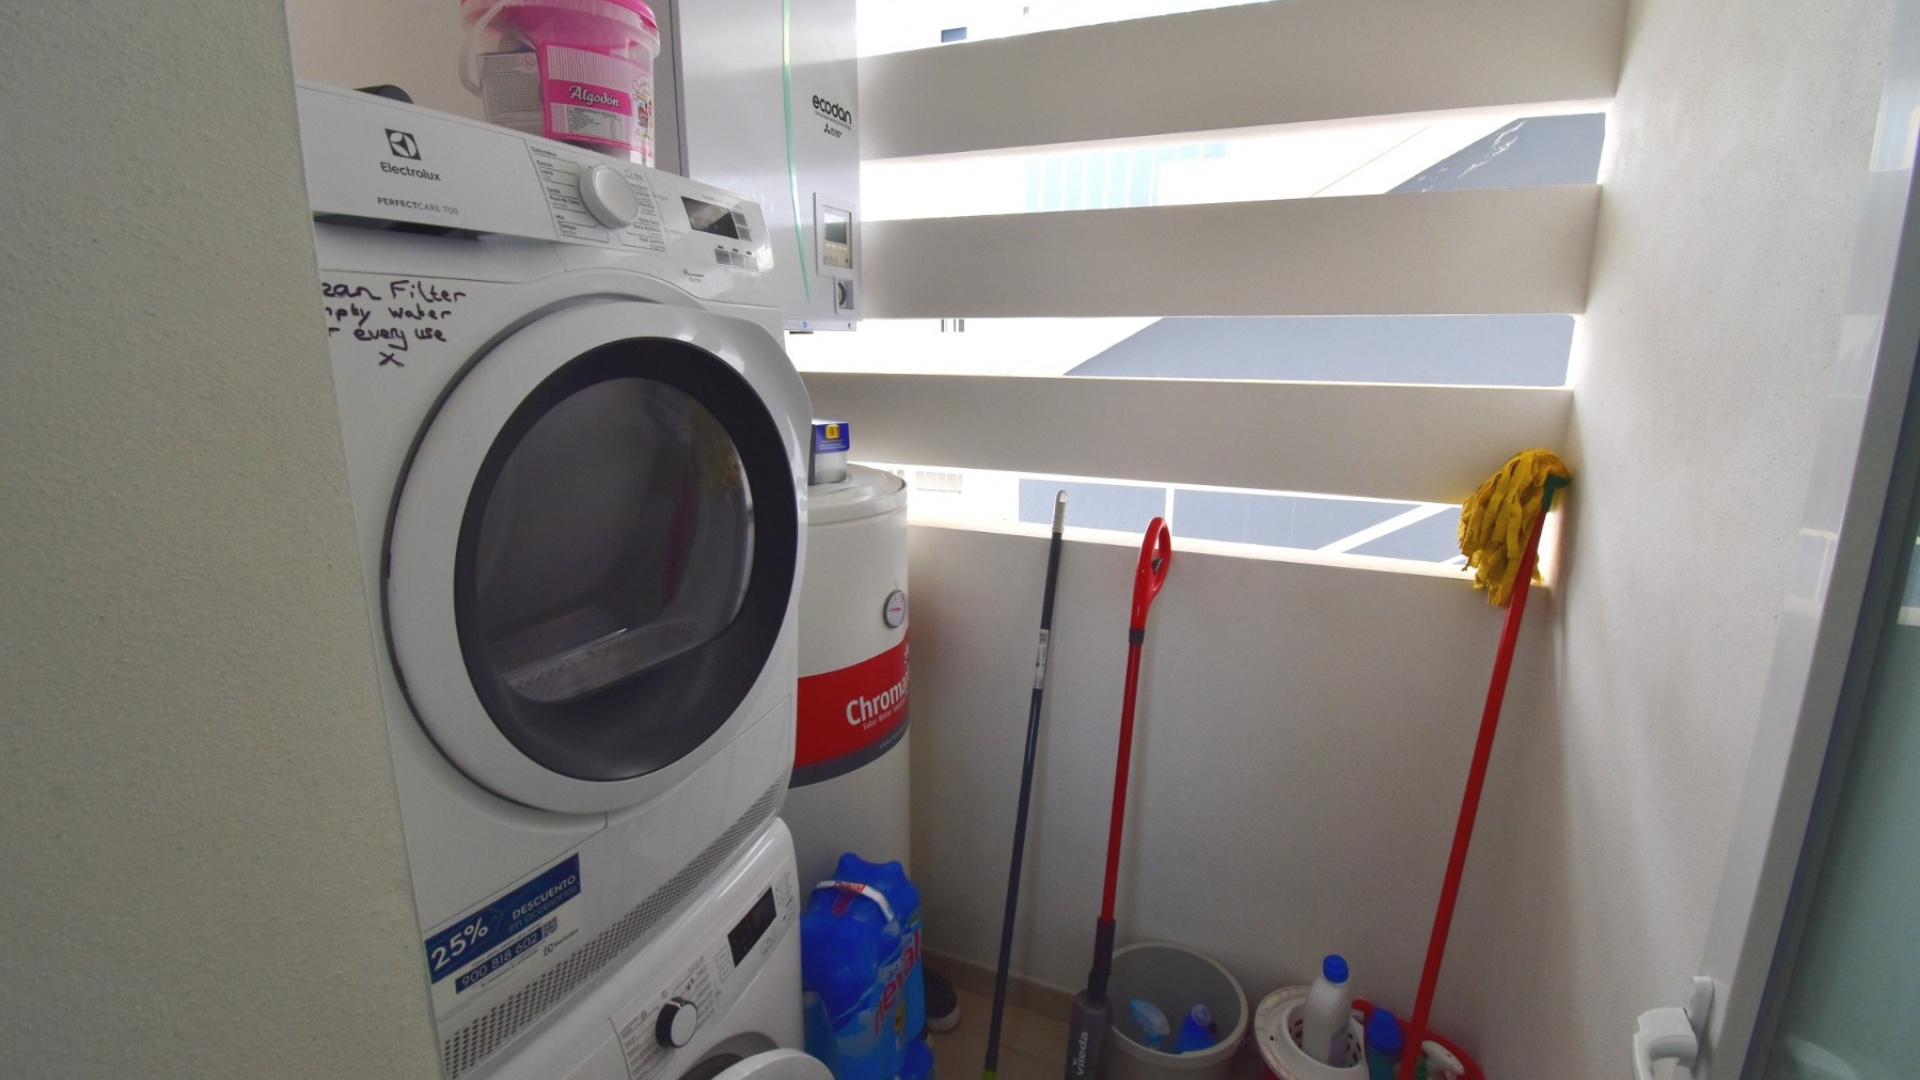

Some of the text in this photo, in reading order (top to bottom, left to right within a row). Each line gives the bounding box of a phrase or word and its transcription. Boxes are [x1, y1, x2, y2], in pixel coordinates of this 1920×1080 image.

[568, 85, 620, 108] Algodón
[812, 94, 852, 124] ecodan
[379, 161, 441, 182] Electrolux
[377, 196, 459, 216] PERFECTCARE 700
[390, 279, 467, 302] Filter
[354, 327, 409, 351] every
[415, 327, 447, 342] use
[512, 874, 576, 920] DESCUENTO
[508, 919, 522, 933] en
[430, 916, 489, 972] 25%
[461, 964, 488, 987] 900
[491, 948, 512, 969] 818
[515, 932, 538, 954] 602
[1072, 1030, 1089, 1076] vileda
